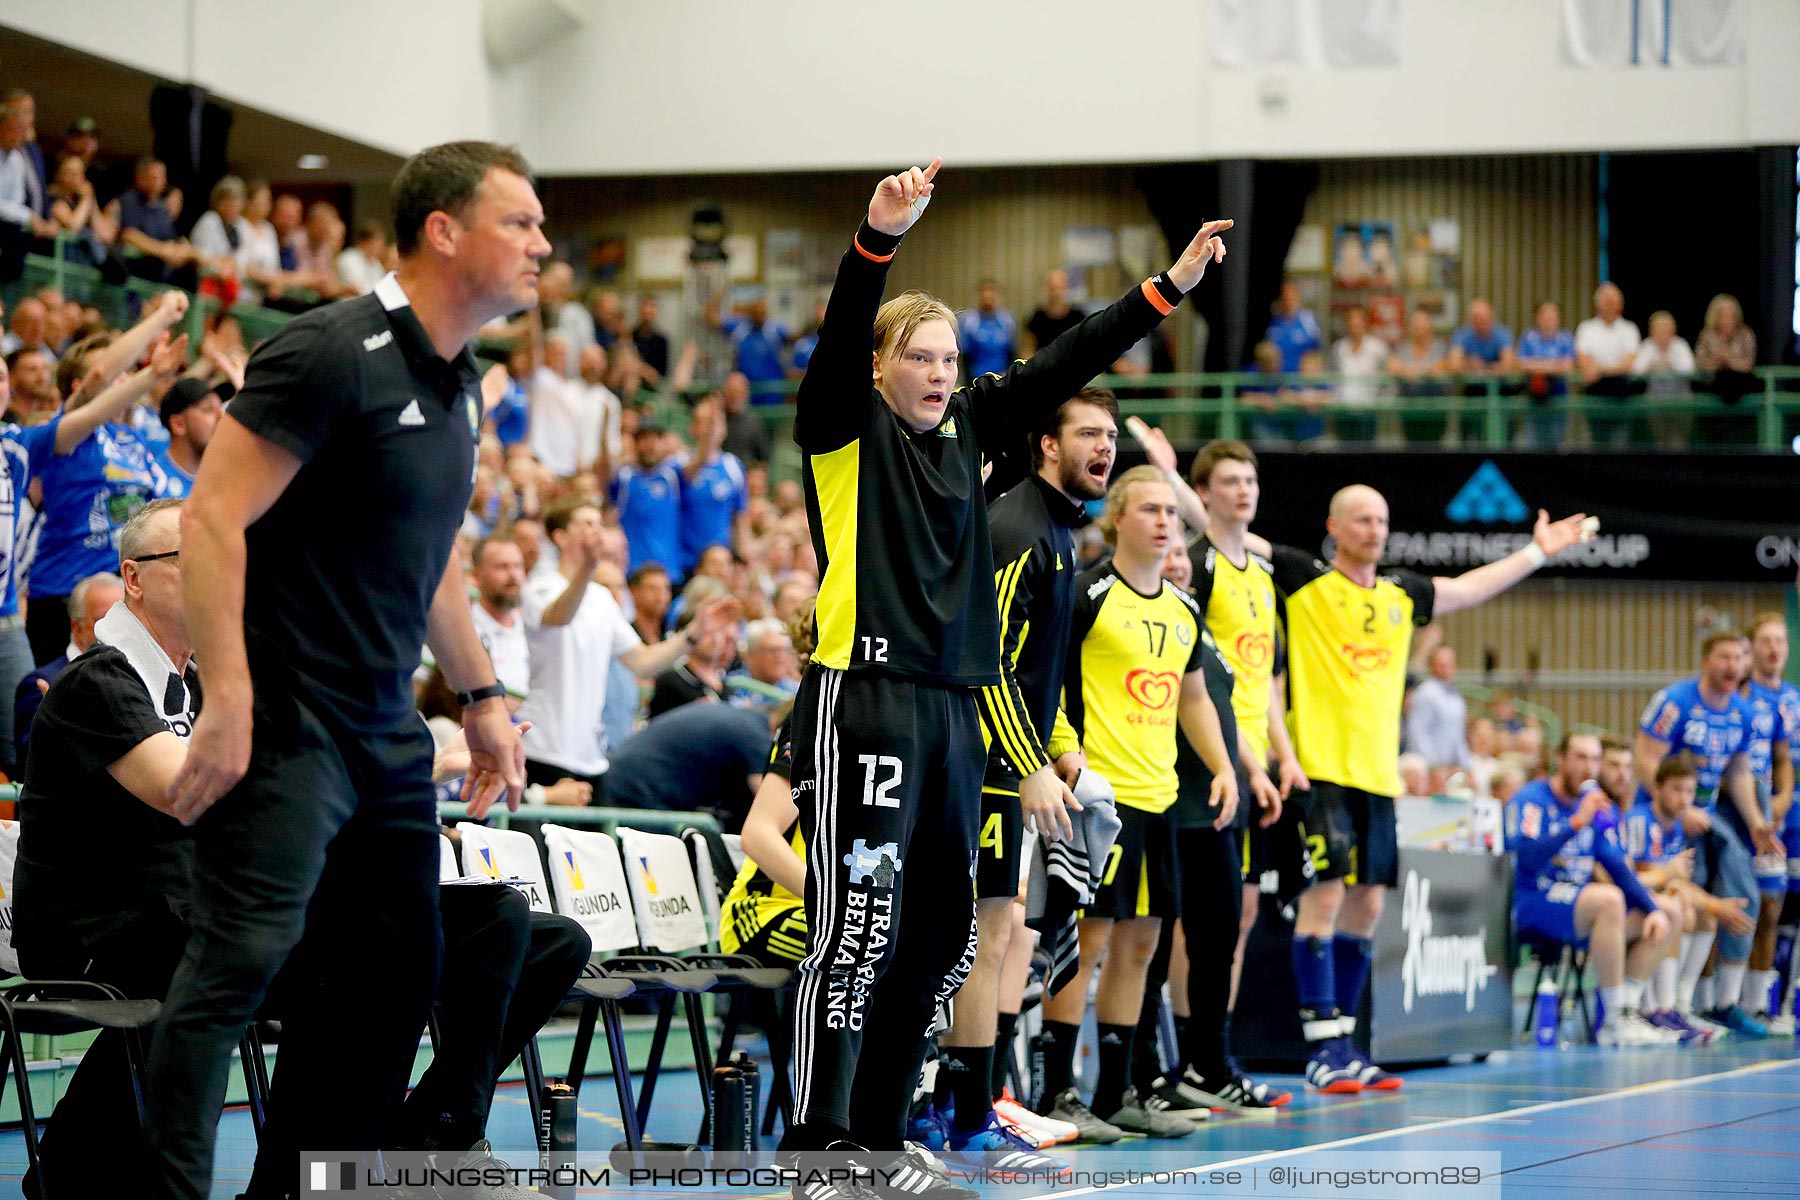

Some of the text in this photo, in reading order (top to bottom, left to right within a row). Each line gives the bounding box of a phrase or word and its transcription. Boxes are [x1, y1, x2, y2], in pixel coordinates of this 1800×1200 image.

[861, 636, 889, 662] 12
[1142, 620, 1167, 658] 17
[858, 754, 903, 808] 12
